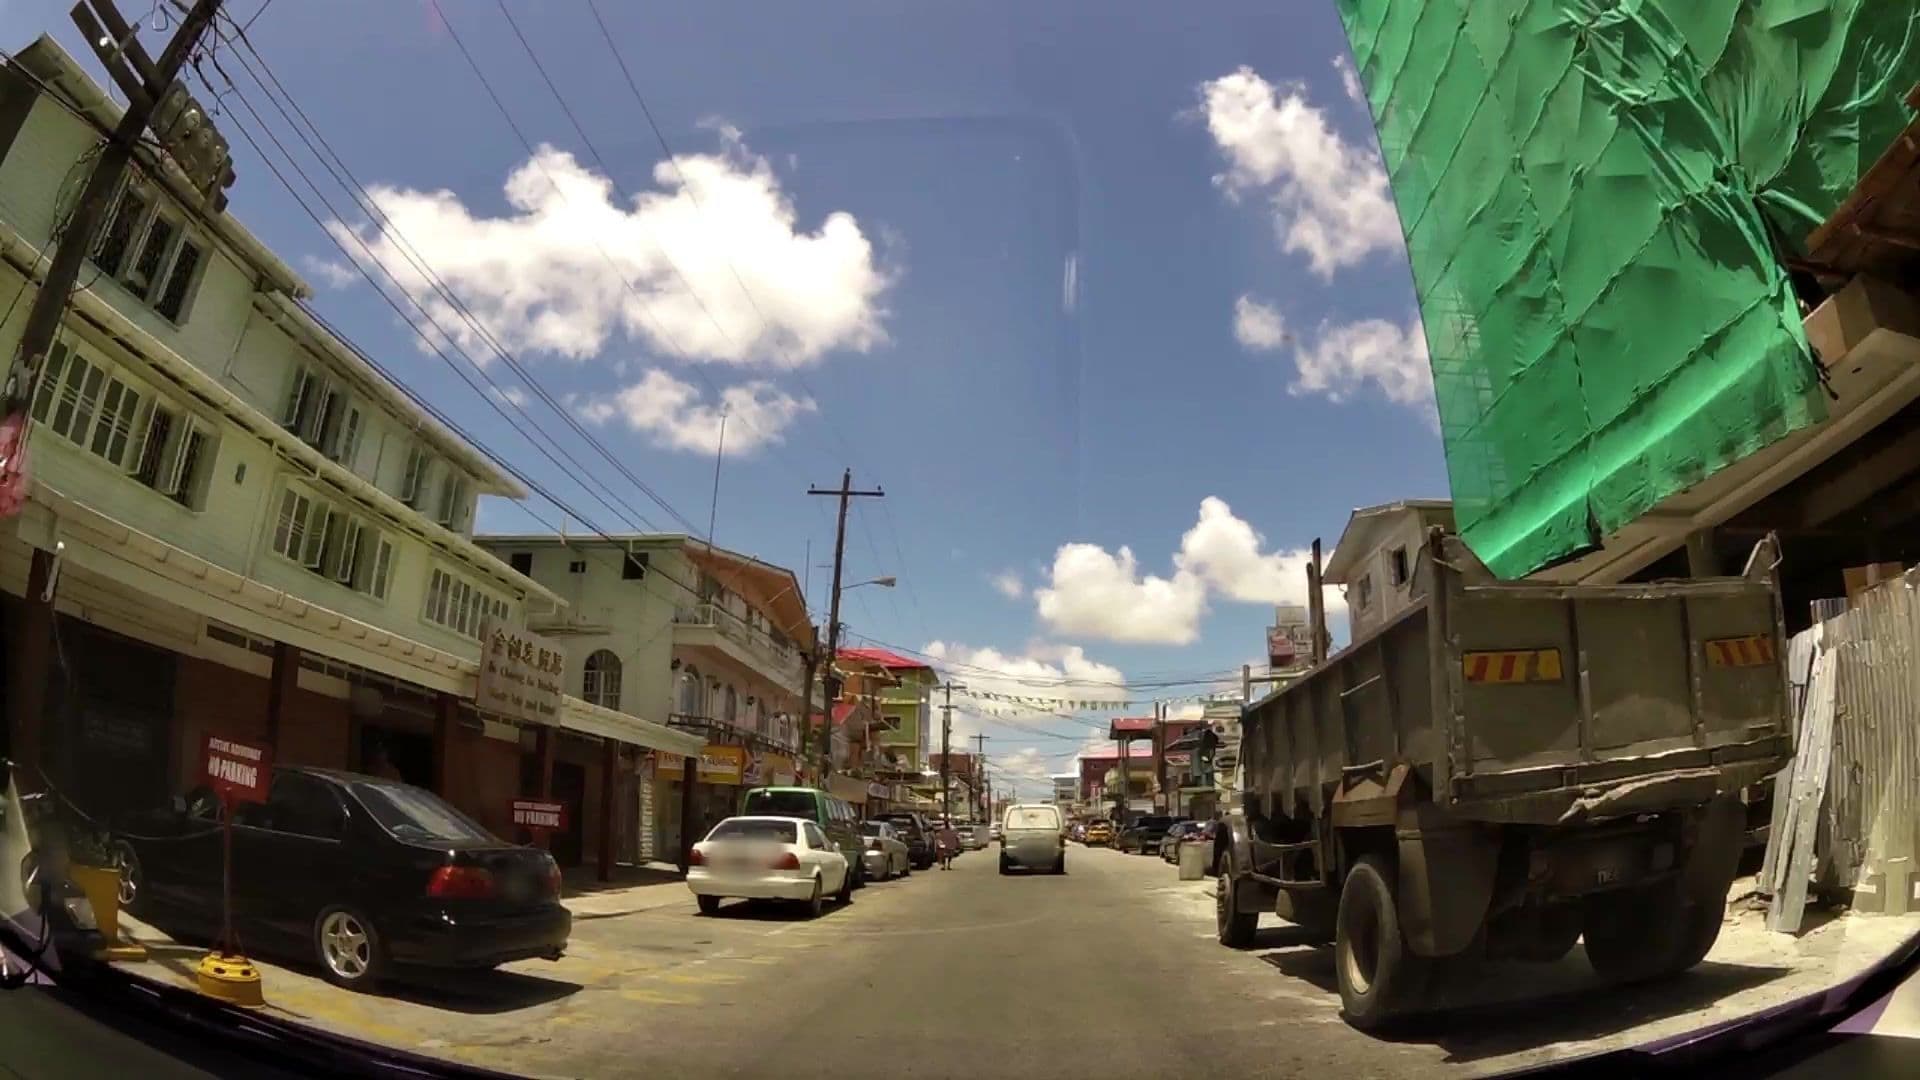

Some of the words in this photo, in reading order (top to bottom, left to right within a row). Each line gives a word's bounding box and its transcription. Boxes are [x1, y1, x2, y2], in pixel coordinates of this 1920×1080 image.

[208, 755, 220, 777] NO
[220, 759, 257, 789] PARKING
[513, 810, 524, 824] NO
[526, 810, 560, 827] PARKING
